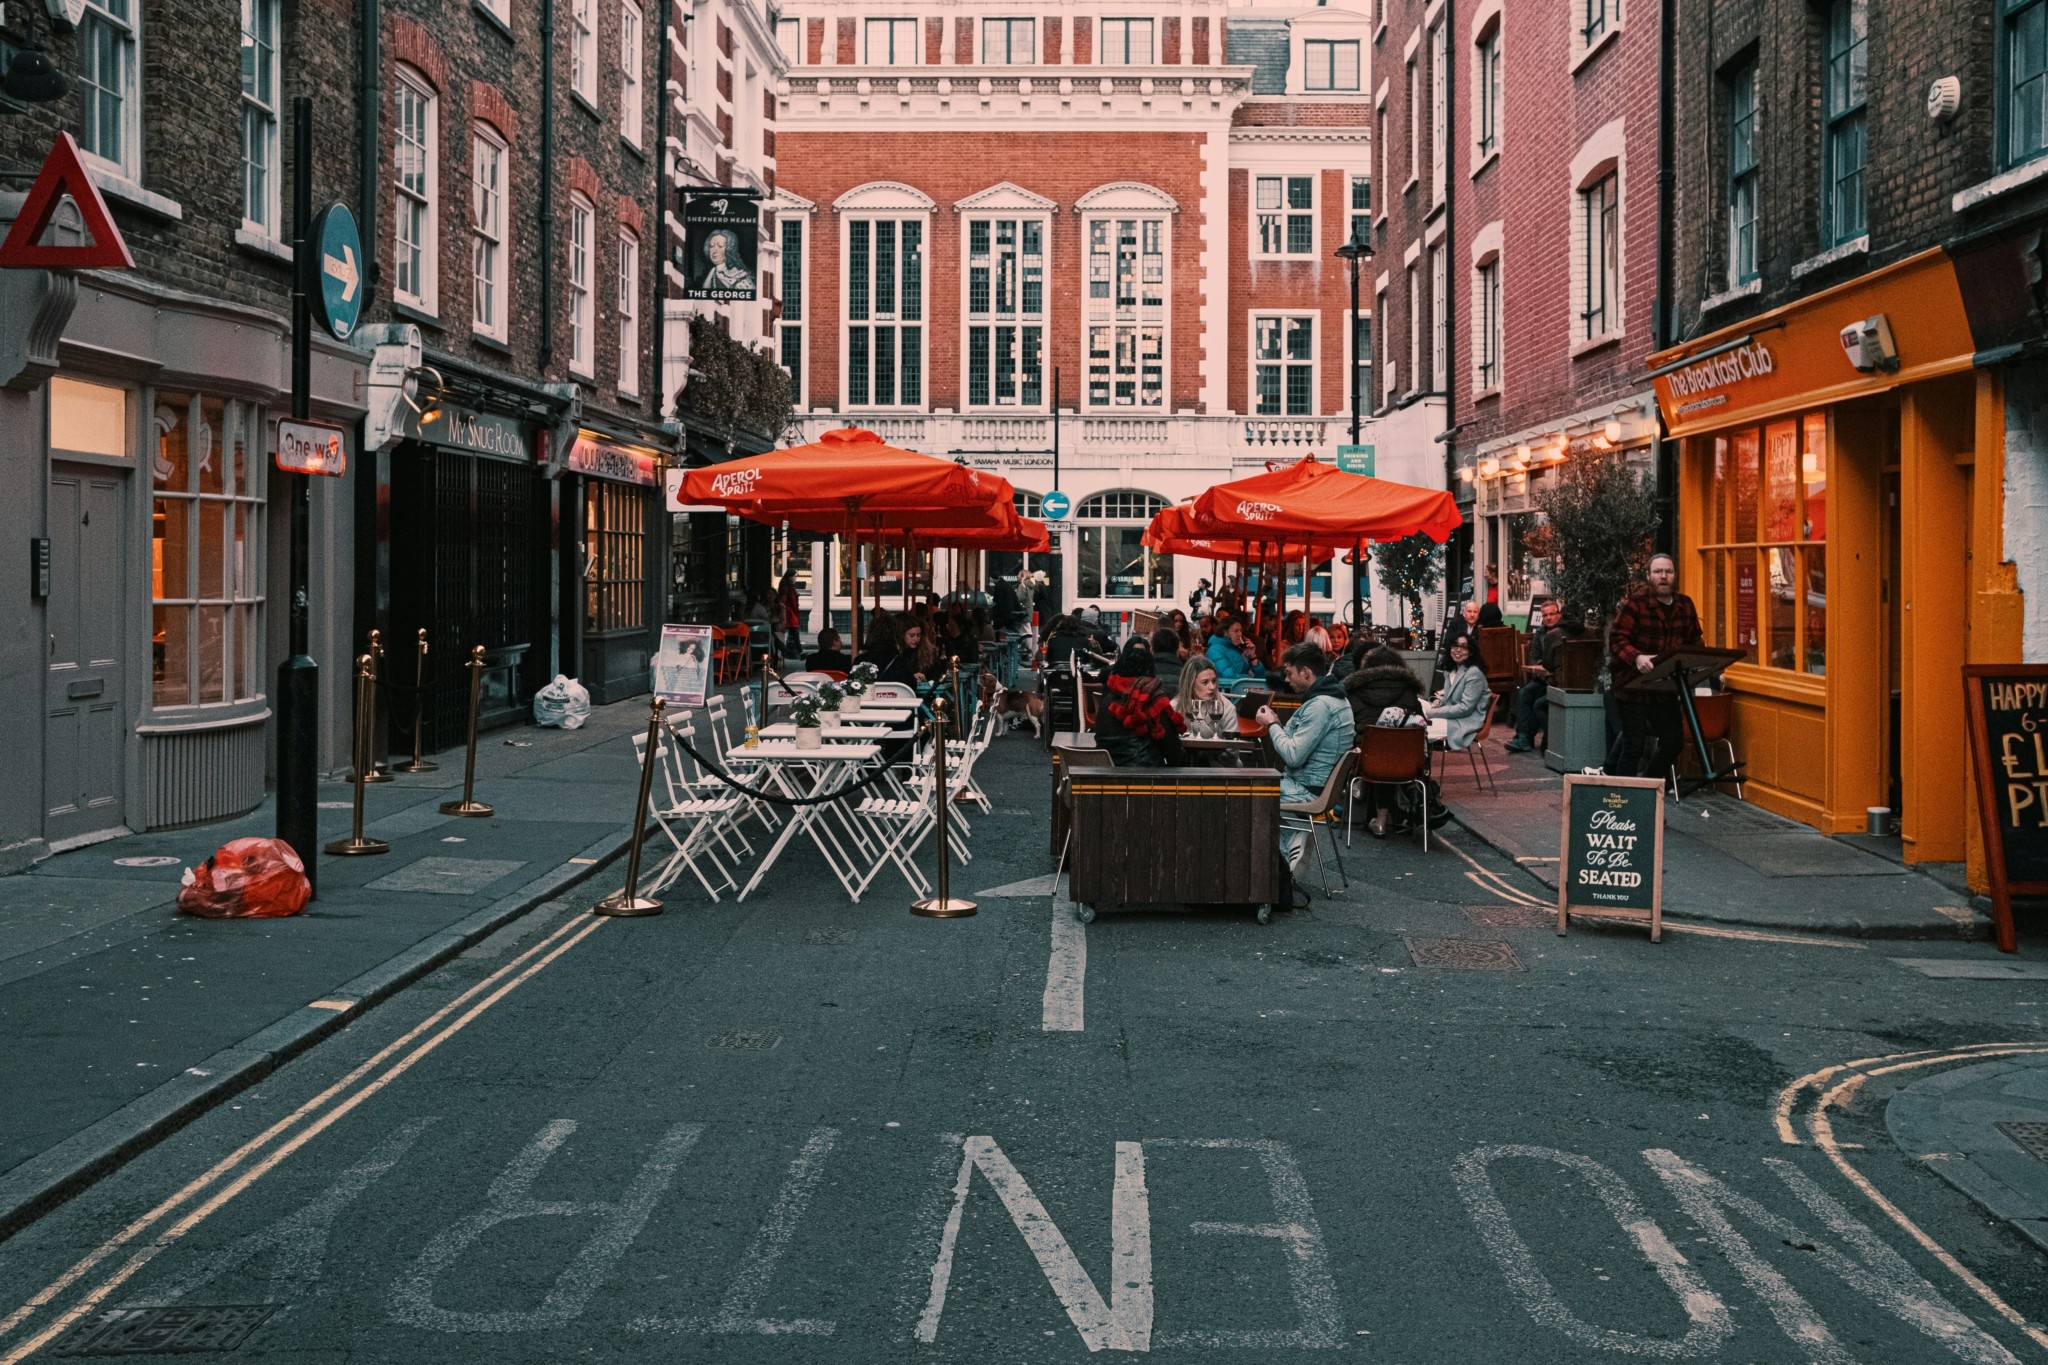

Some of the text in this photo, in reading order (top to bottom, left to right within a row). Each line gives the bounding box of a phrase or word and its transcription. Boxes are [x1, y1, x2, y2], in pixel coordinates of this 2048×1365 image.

[730, 216, 757, 224] NEAME
[688, 289, 751, 299] THE GEORGE
[1666, 342, 1773, 398] The Breakfast Club
[285, 433, 339, 464] One way
[711, 468, 763, 491] APEROL
[719, 481, 756, 497] SPRITZ
[1236, 500, 1283, 514] APEROL
[1244, 512, 1274, 521] SPRITZ
[1989, 682, 2048, 710] HAPPY
[1589, 810, 1636, 831] Please
[1586, 833, 1637, 850] WAIT
[1586, 849, 1632, 868] To Be
[1579, 869, 1642, 887] SEATED
[1592, 892, 1616, 900] THANK
